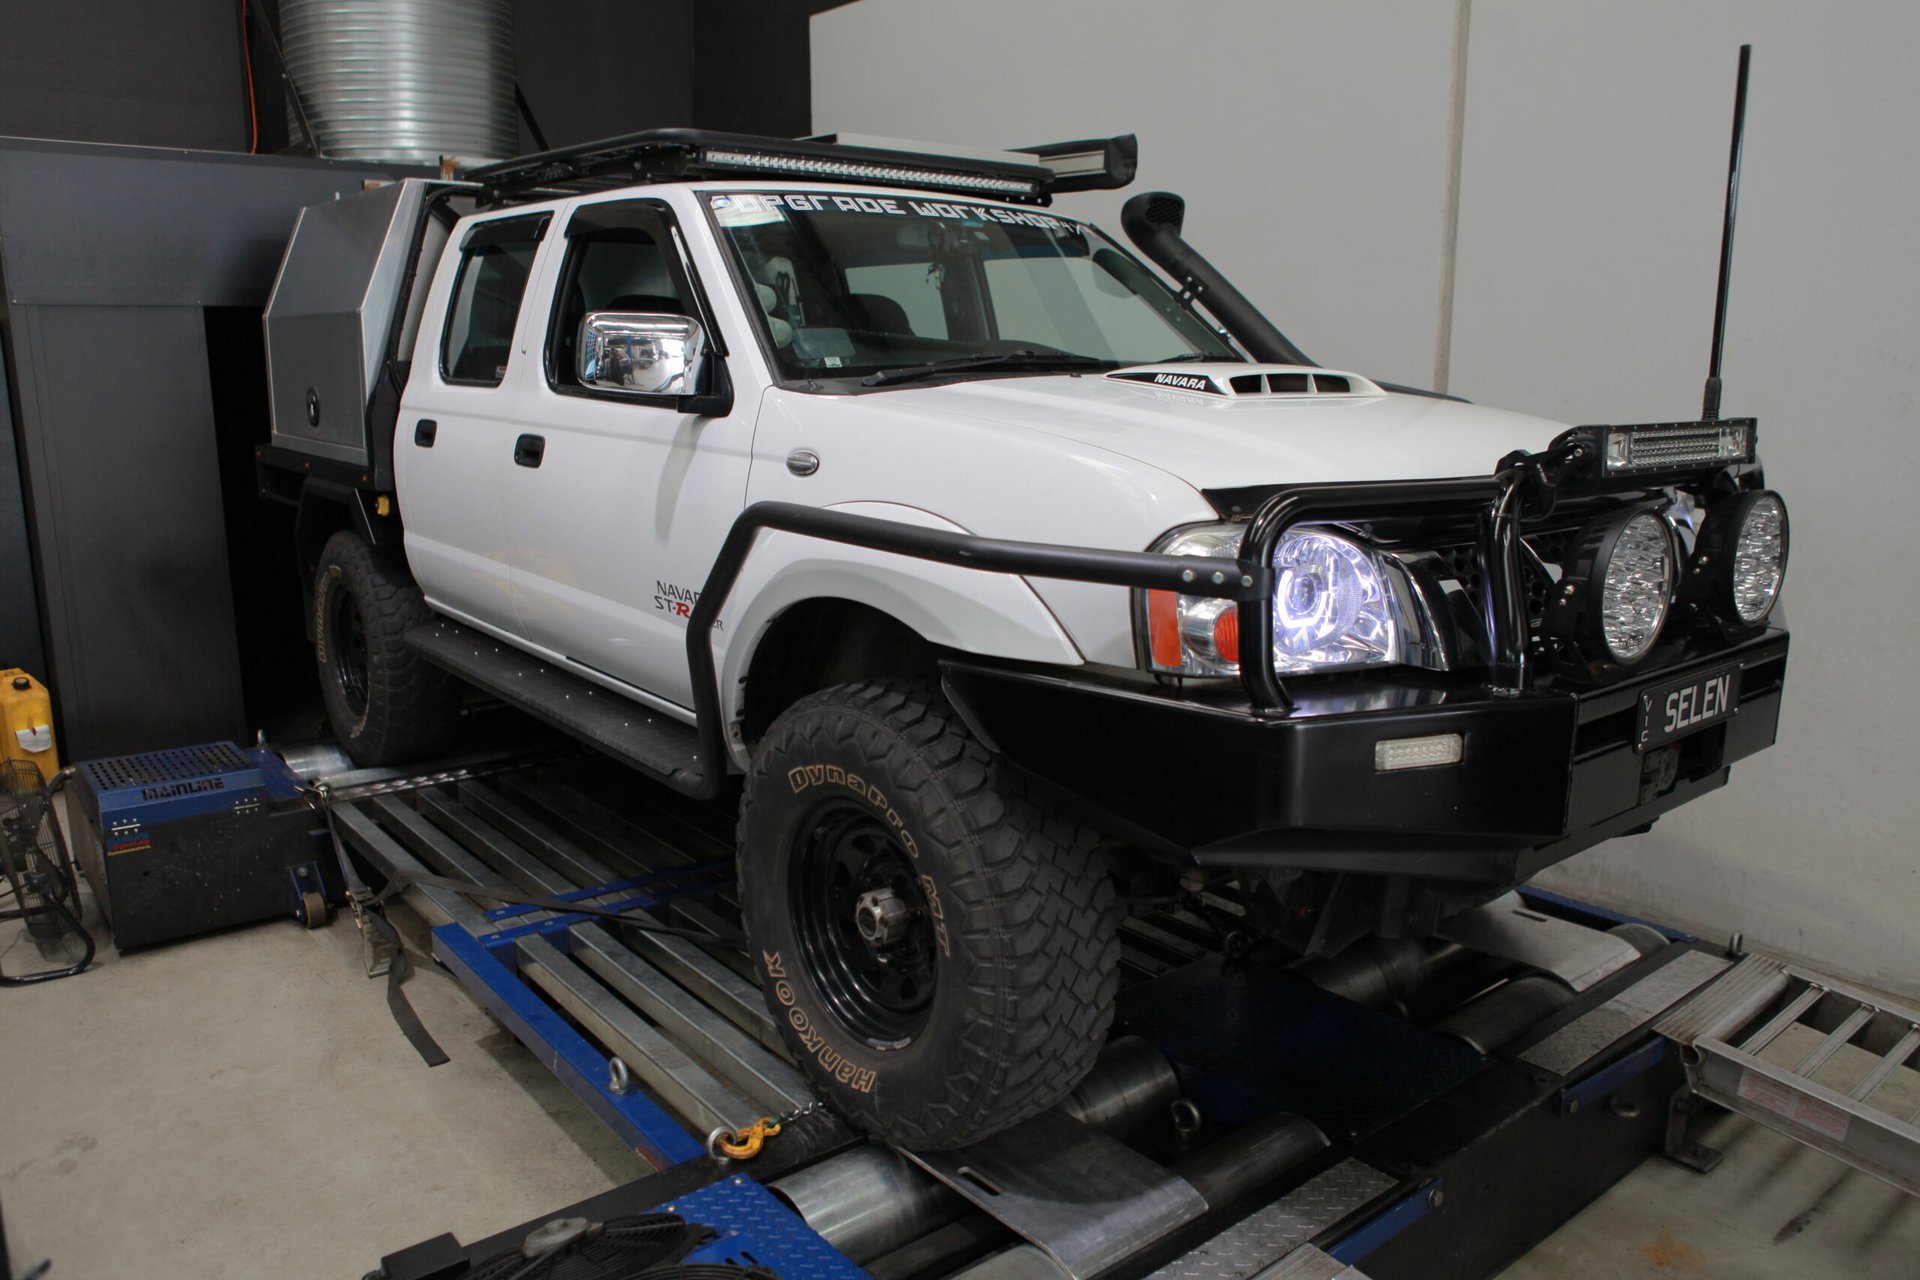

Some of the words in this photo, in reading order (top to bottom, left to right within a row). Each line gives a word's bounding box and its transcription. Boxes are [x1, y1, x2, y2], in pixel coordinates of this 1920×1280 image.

[735, 194, 907, 215] UPGRADE
[908, 201, 1062, 231] WORKSHOP
[1154, 373, 1206, 391] NAVARA
[654, 595, 690, 619] ST-R
[1641, 699, 1652, 742] VIC
[1664, 674, 1730, 733] SELEN
